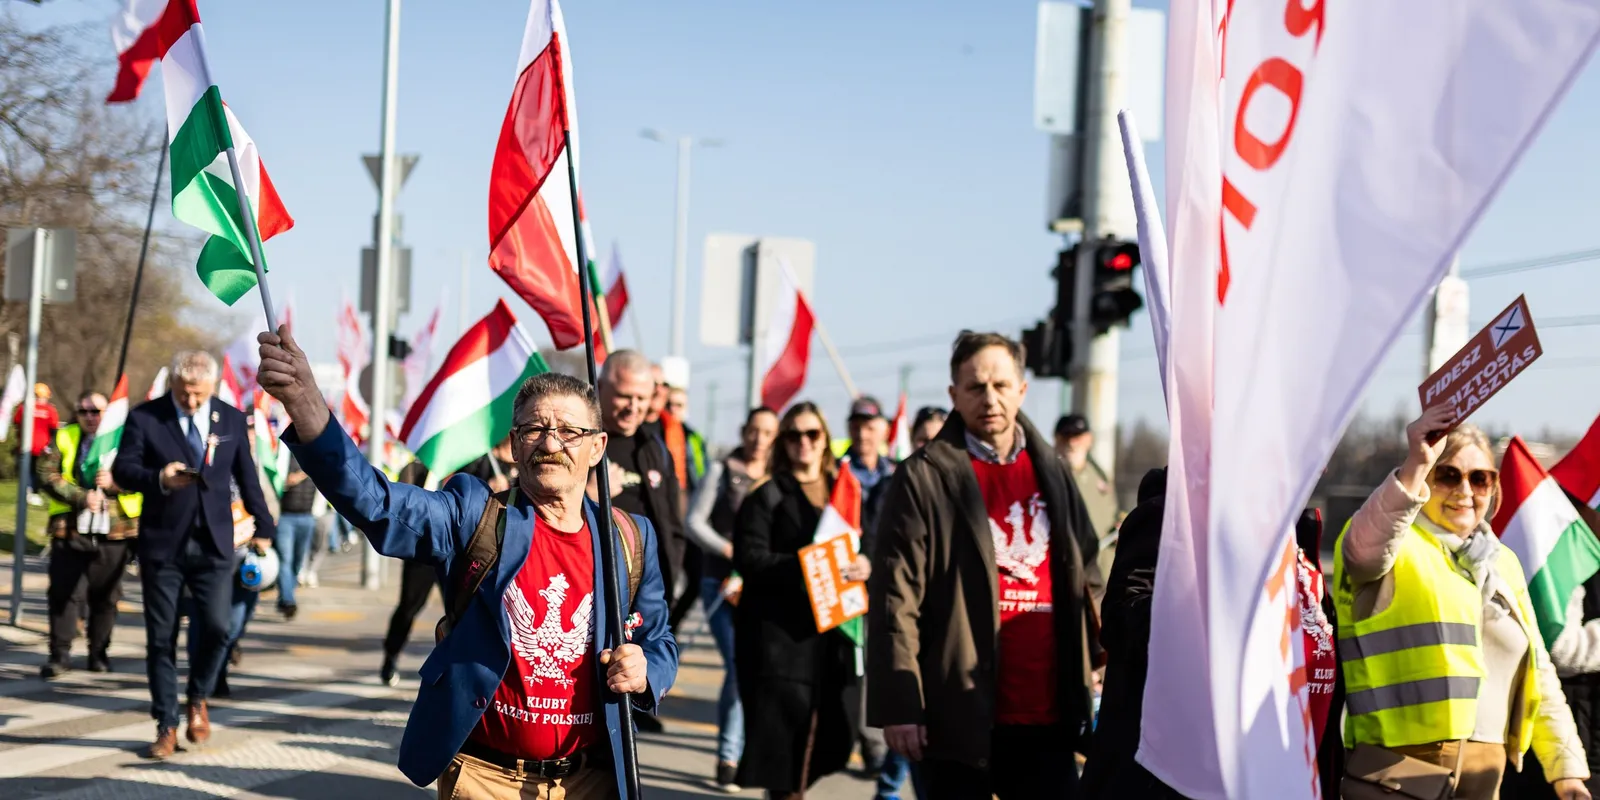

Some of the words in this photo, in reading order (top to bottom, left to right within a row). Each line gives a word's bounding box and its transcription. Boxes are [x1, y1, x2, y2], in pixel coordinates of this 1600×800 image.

[1426, 344, 1482, 404] FIDESZ
[1450, 345, 1536, 423] LASZTÁS
[494, 700, 540, 724] GAZETY
[542, 712, 594, 725] POLSKIEJ
[526, 696, 568, 710] KLUBY
